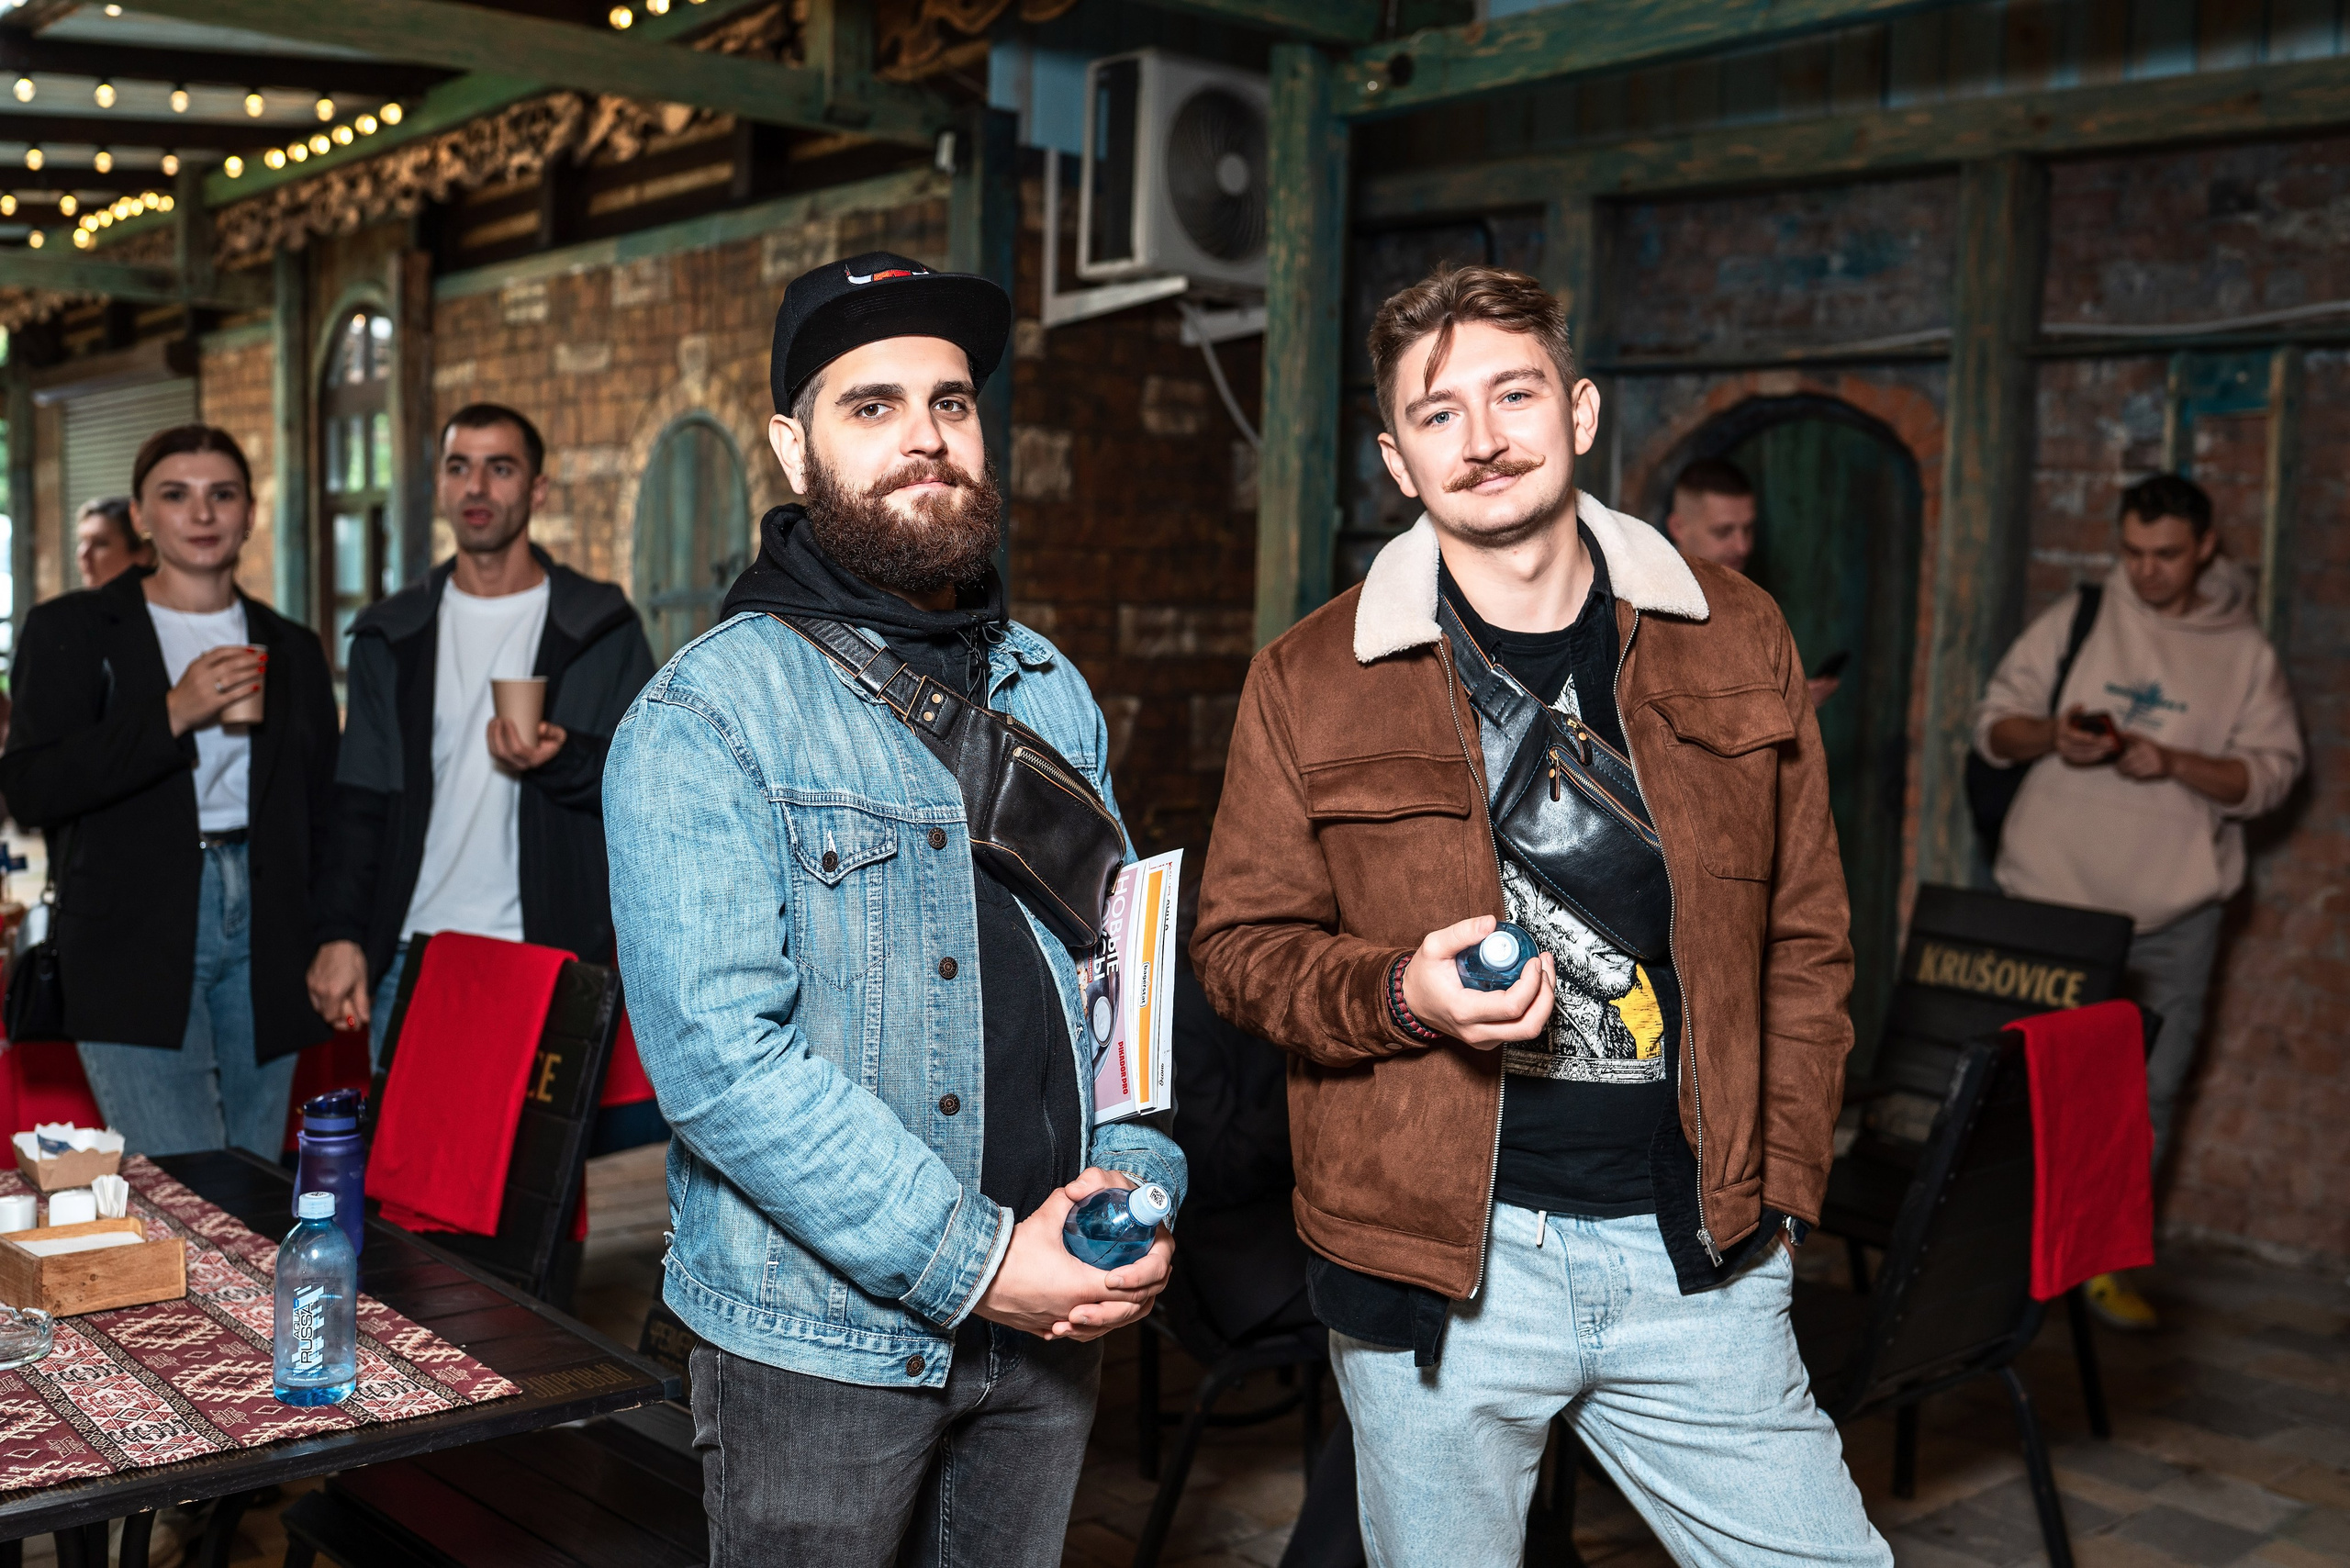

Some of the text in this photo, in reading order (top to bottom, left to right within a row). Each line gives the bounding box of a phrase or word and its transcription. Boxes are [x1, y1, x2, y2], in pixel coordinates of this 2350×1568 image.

[1106, 875, 1127, 975] НОВЫЕ
[1917, 943, 2087, 1008] KRUŠOVICE
[1117, 1040, 1129, 1095] PIKADOR PRO
[293, 1308, 301, 1338] AQUA
